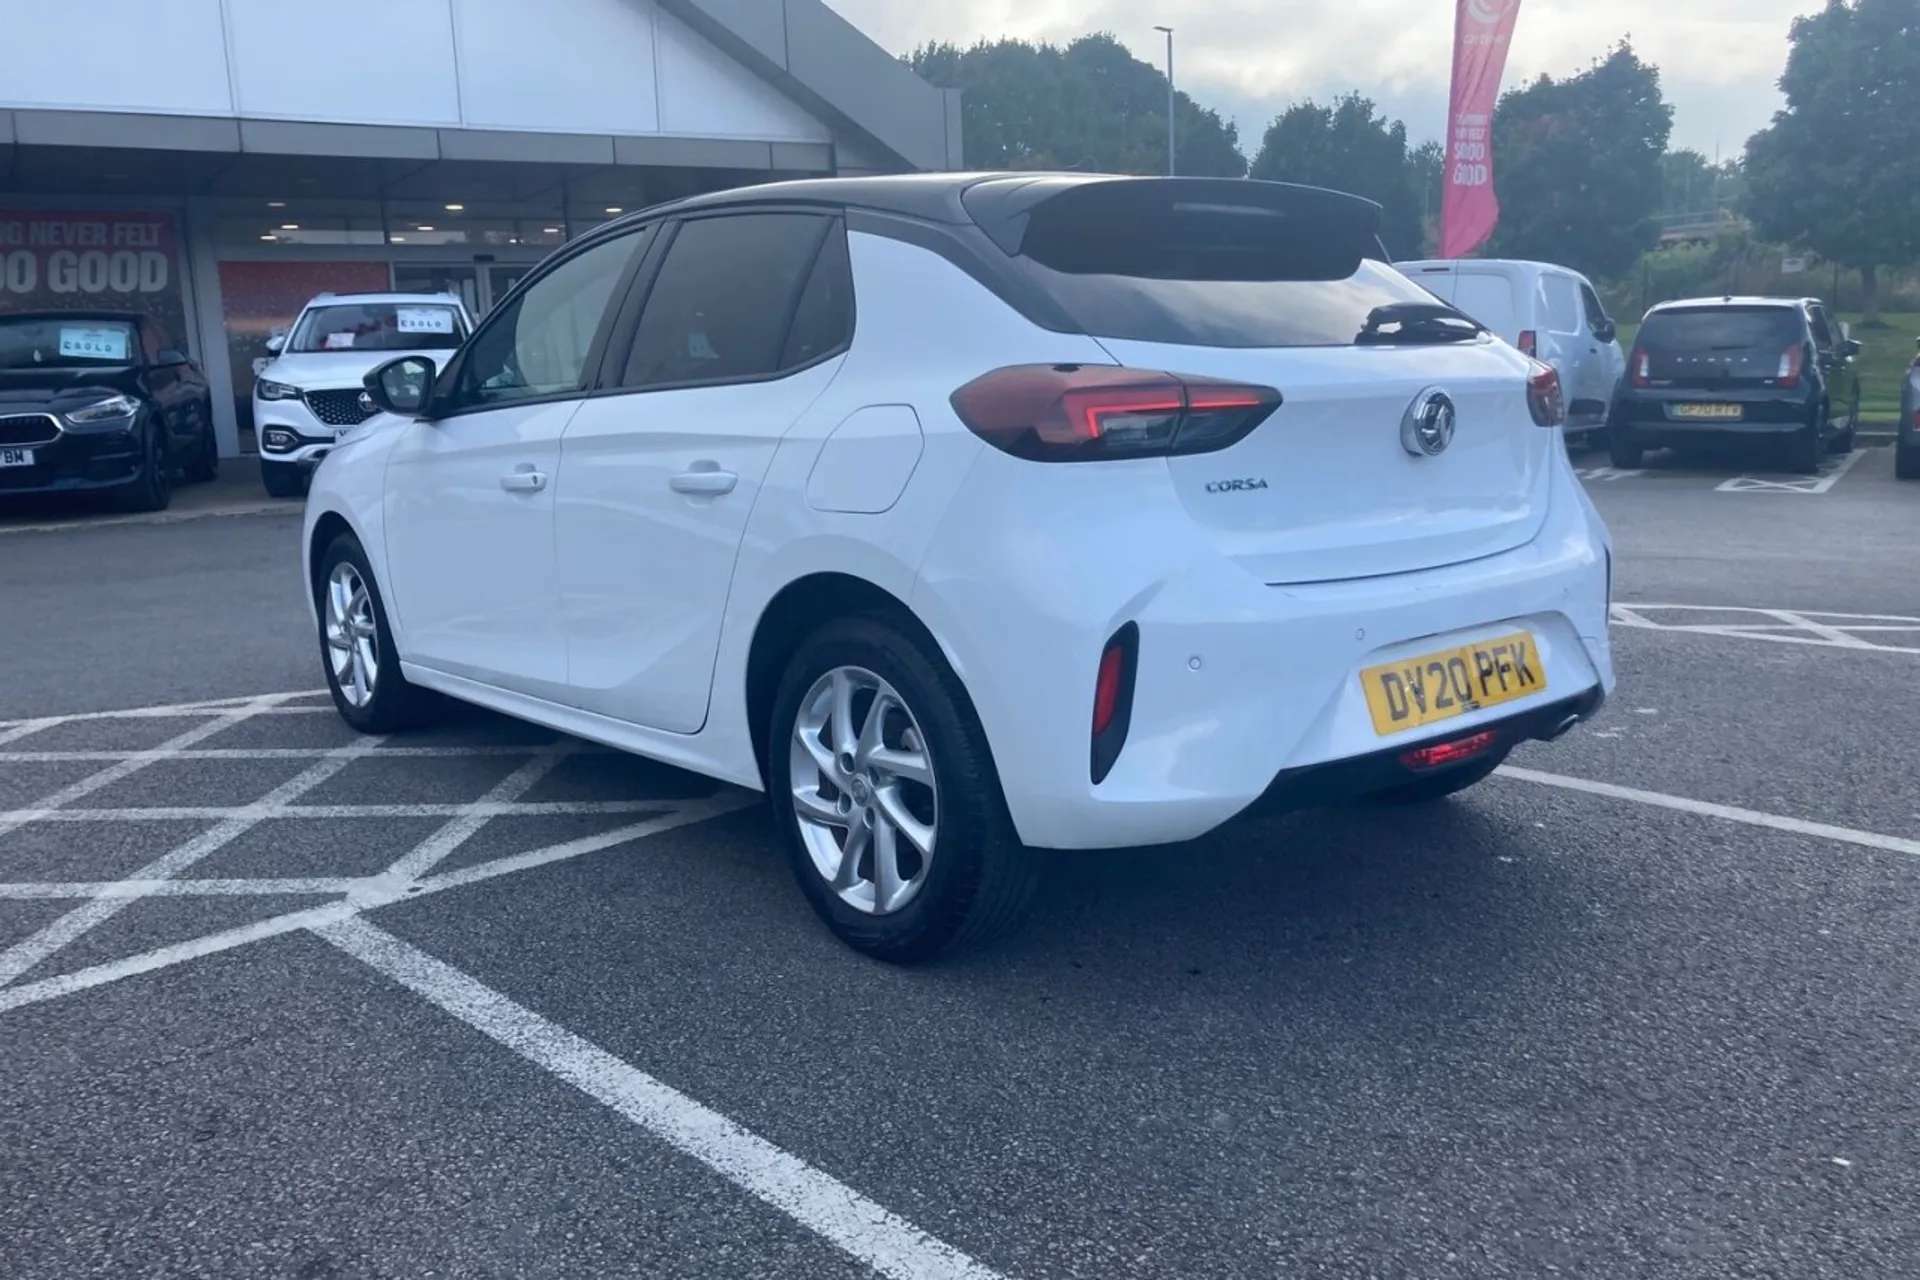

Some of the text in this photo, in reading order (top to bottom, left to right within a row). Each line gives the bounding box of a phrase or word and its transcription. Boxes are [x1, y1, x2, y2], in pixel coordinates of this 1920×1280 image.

[29, 221, 107, 246] NEVER
[112, 222, 162, 246] FELT
[47, 250, 168, 293] GOOD
[1205, 478, 1268, 493] CORSA
[1381, 641, 1535, 721] DV20 PFK
